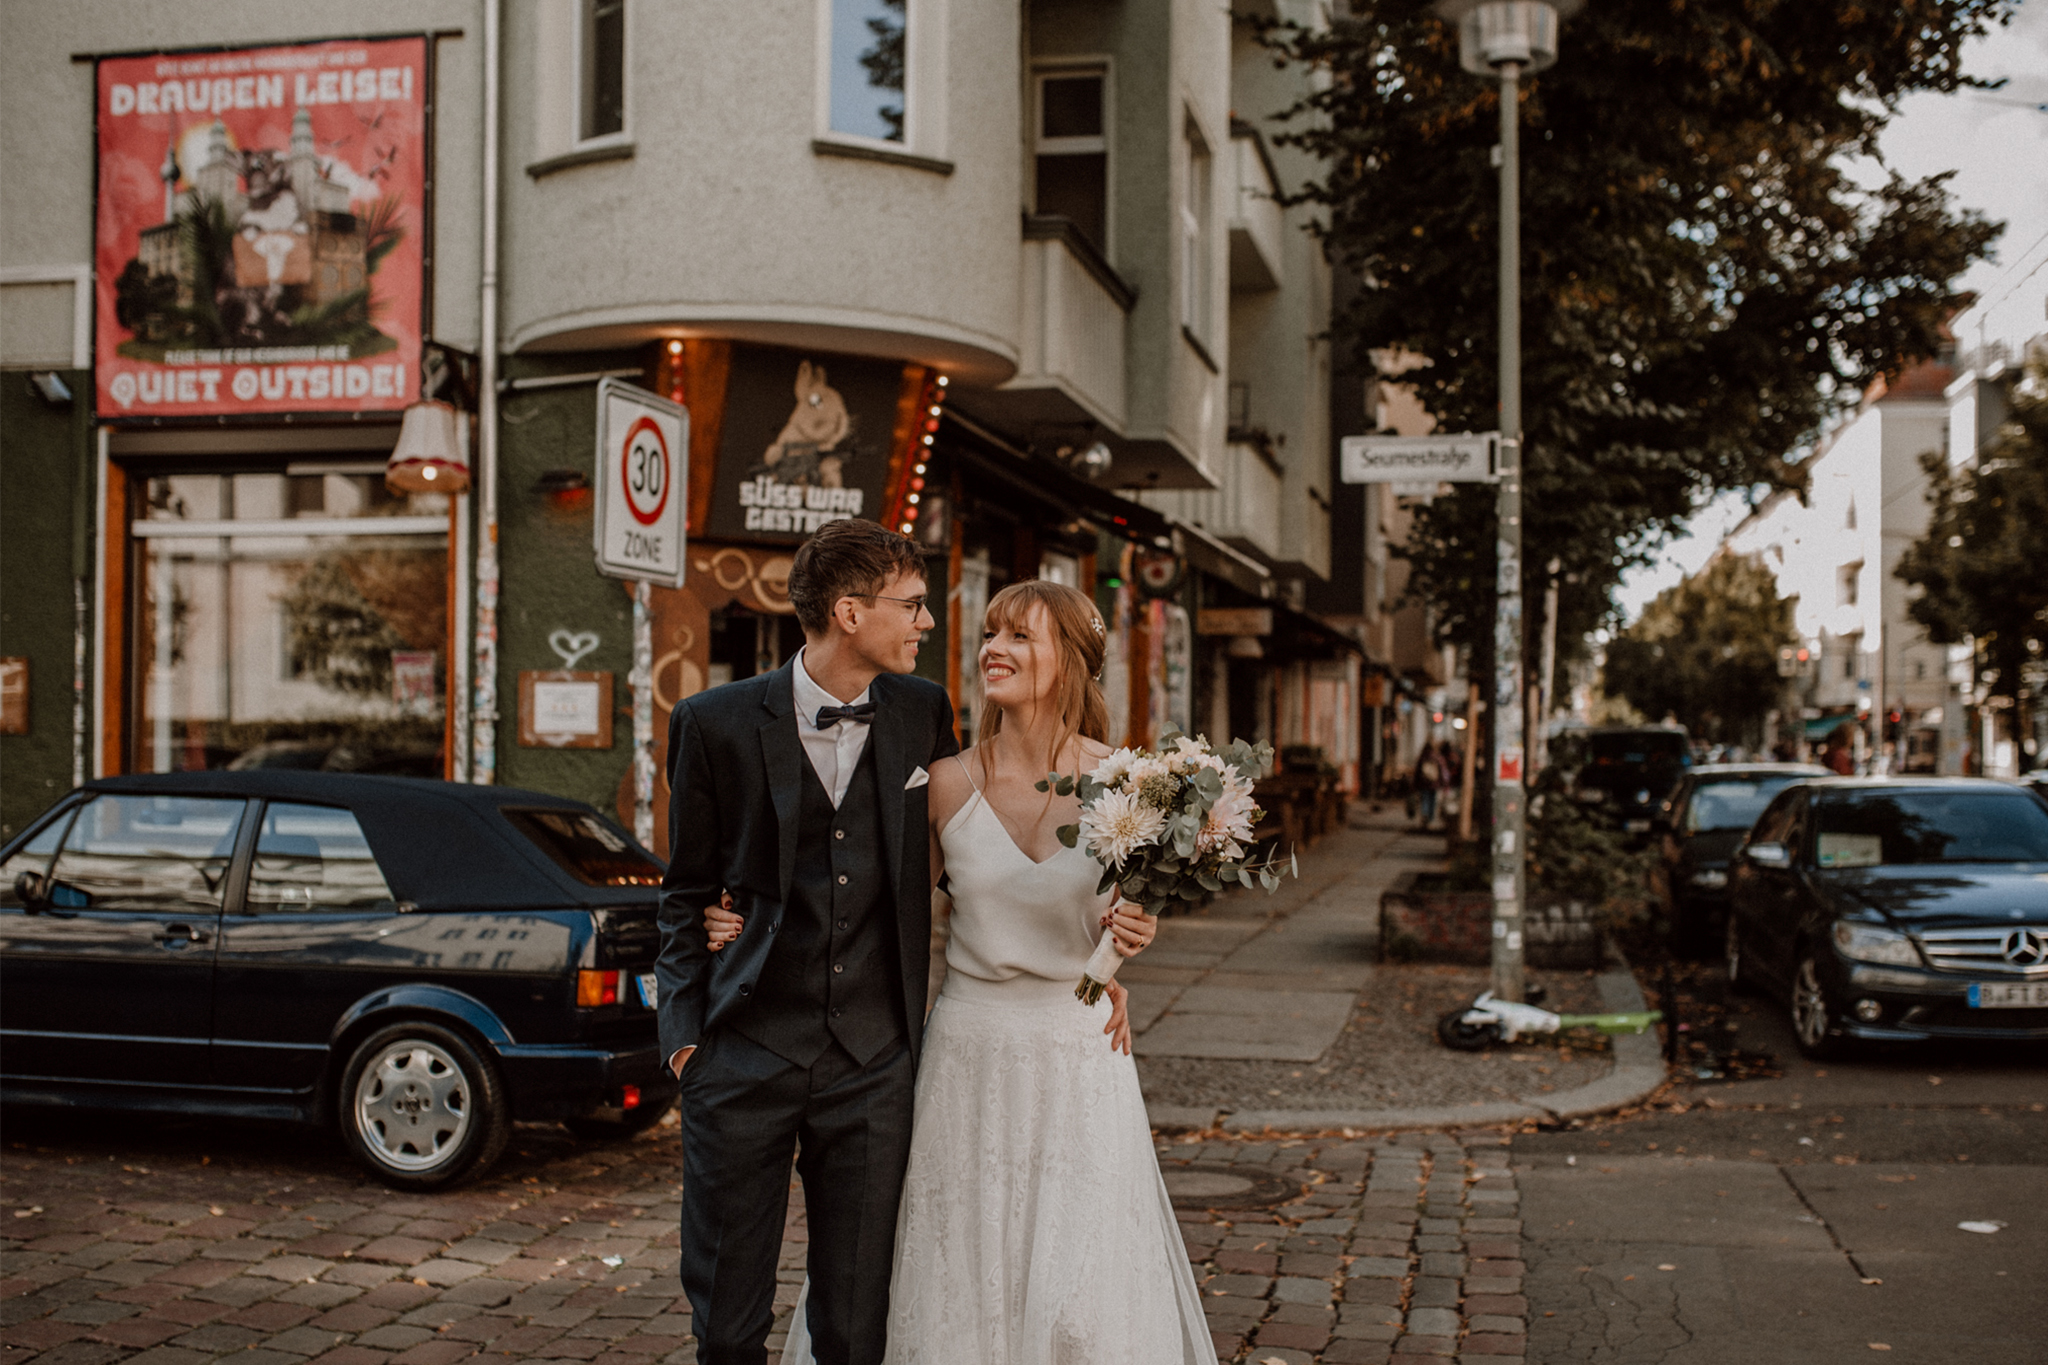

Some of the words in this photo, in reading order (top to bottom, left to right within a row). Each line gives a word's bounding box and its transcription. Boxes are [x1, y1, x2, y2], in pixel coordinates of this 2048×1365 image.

[294, 65, 414, 106] LEISE!
[110, 368, 222, 410] QUIET
[231, 364, 405, 401] OUTSIDE!
[632, 445, 661, 496] 30
[739, 474, 803, 509] SÜSS
[805, 484, 864, 516] WAR
[745, 506, 853, 533] GESTE
[623, 530, 662, 563] ZONE
